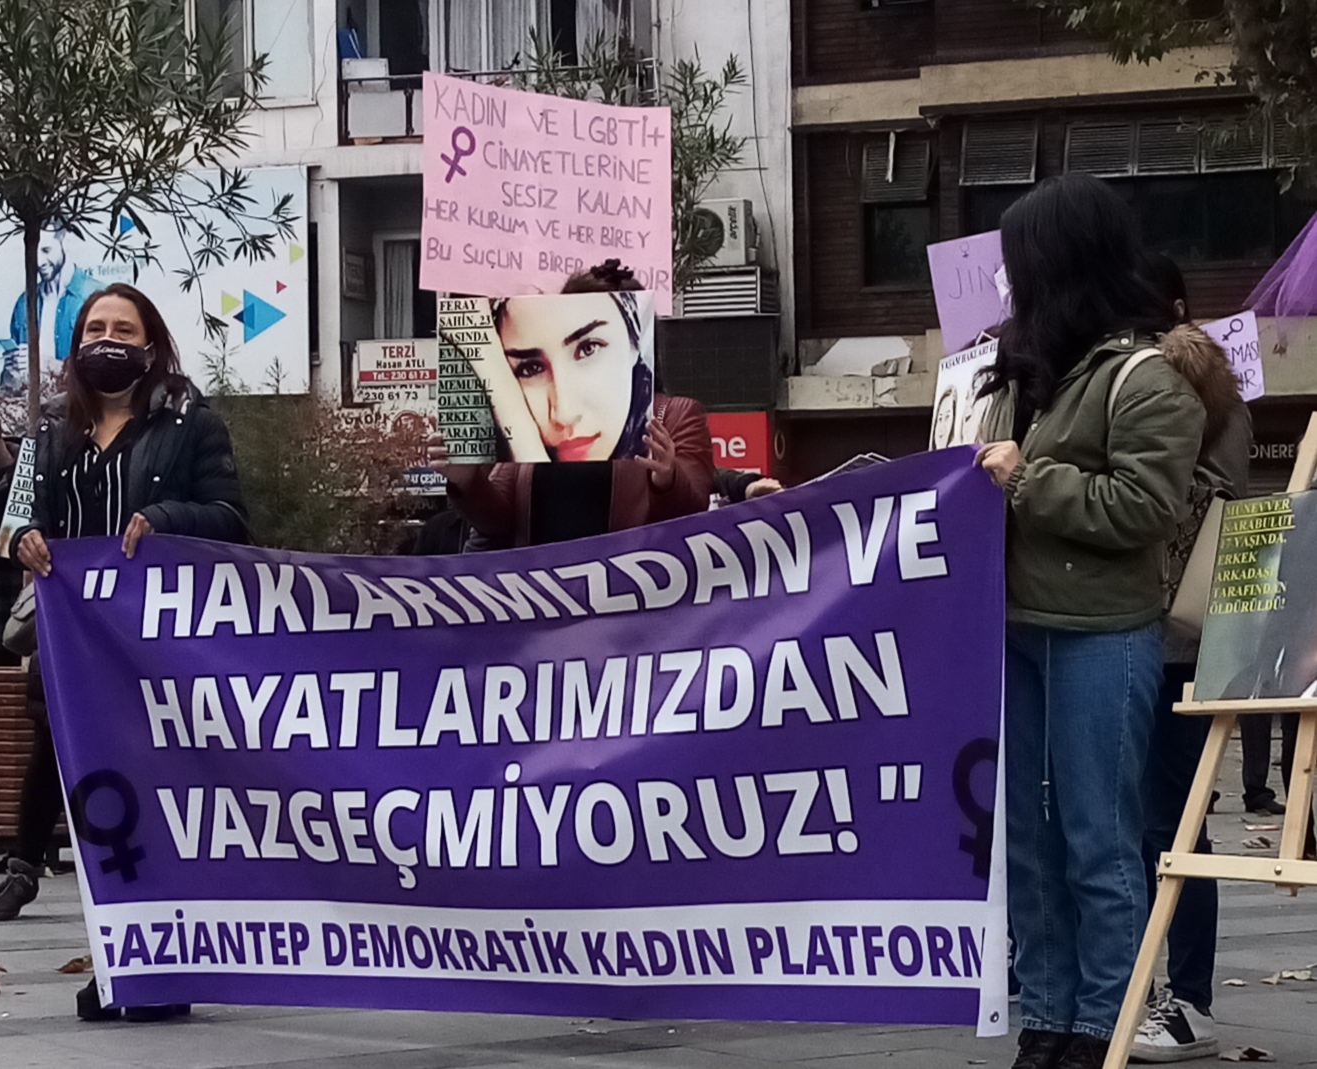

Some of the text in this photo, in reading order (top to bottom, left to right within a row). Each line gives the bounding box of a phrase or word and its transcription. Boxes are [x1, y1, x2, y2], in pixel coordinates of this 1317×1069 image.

[434, 80, 506, 128] KADIN
[526, 106, 558, 136] VE
[483, 140, 652, 184] CİNAYETLERİNE
[577, 186, 651, 220] KALAN
[424, 198, 460, 222] HER
[467, 206, 529, 235] KURUM
[535, 219, 561, 239] VE
[569, 224, 594, 244] HER
[439, 300, 477, 311] FERAY
[479, 315, 491, 326] 23
[381, 341, 416, 358] TERZİ
[376, 360, 402, 369] Hasan
[391, 371, 407, 380] 230
[408, 371, 418, 379] 61
[419, 370, 430, 379] 73
[364, 391, 418, 400] 230 61 73
[438, 395, 470, 406] OLAN
[438, 411, 478, 422] ERKEK
[1222, 514, 1295, 533] KARABULUT
[141, 511, 811, 639] HAKLARIMIZDAN
[831, 490, 948, 585] VE
[1217, 551, 1258, 566] ERKEK
[1209, 595, 1286, 615] ÖLDÜRÜLDÜ!
[139, 631, 909, 750] HAYATLARIMIZDAN
[156, 763, 860, 889] VAZGEÇMİYORUZ!
[99, 909, 310, 968] AZİANTEP
[321, 918, 579, 974] DEMOKRATİK
[582, 927, 735, 976] KADIN
